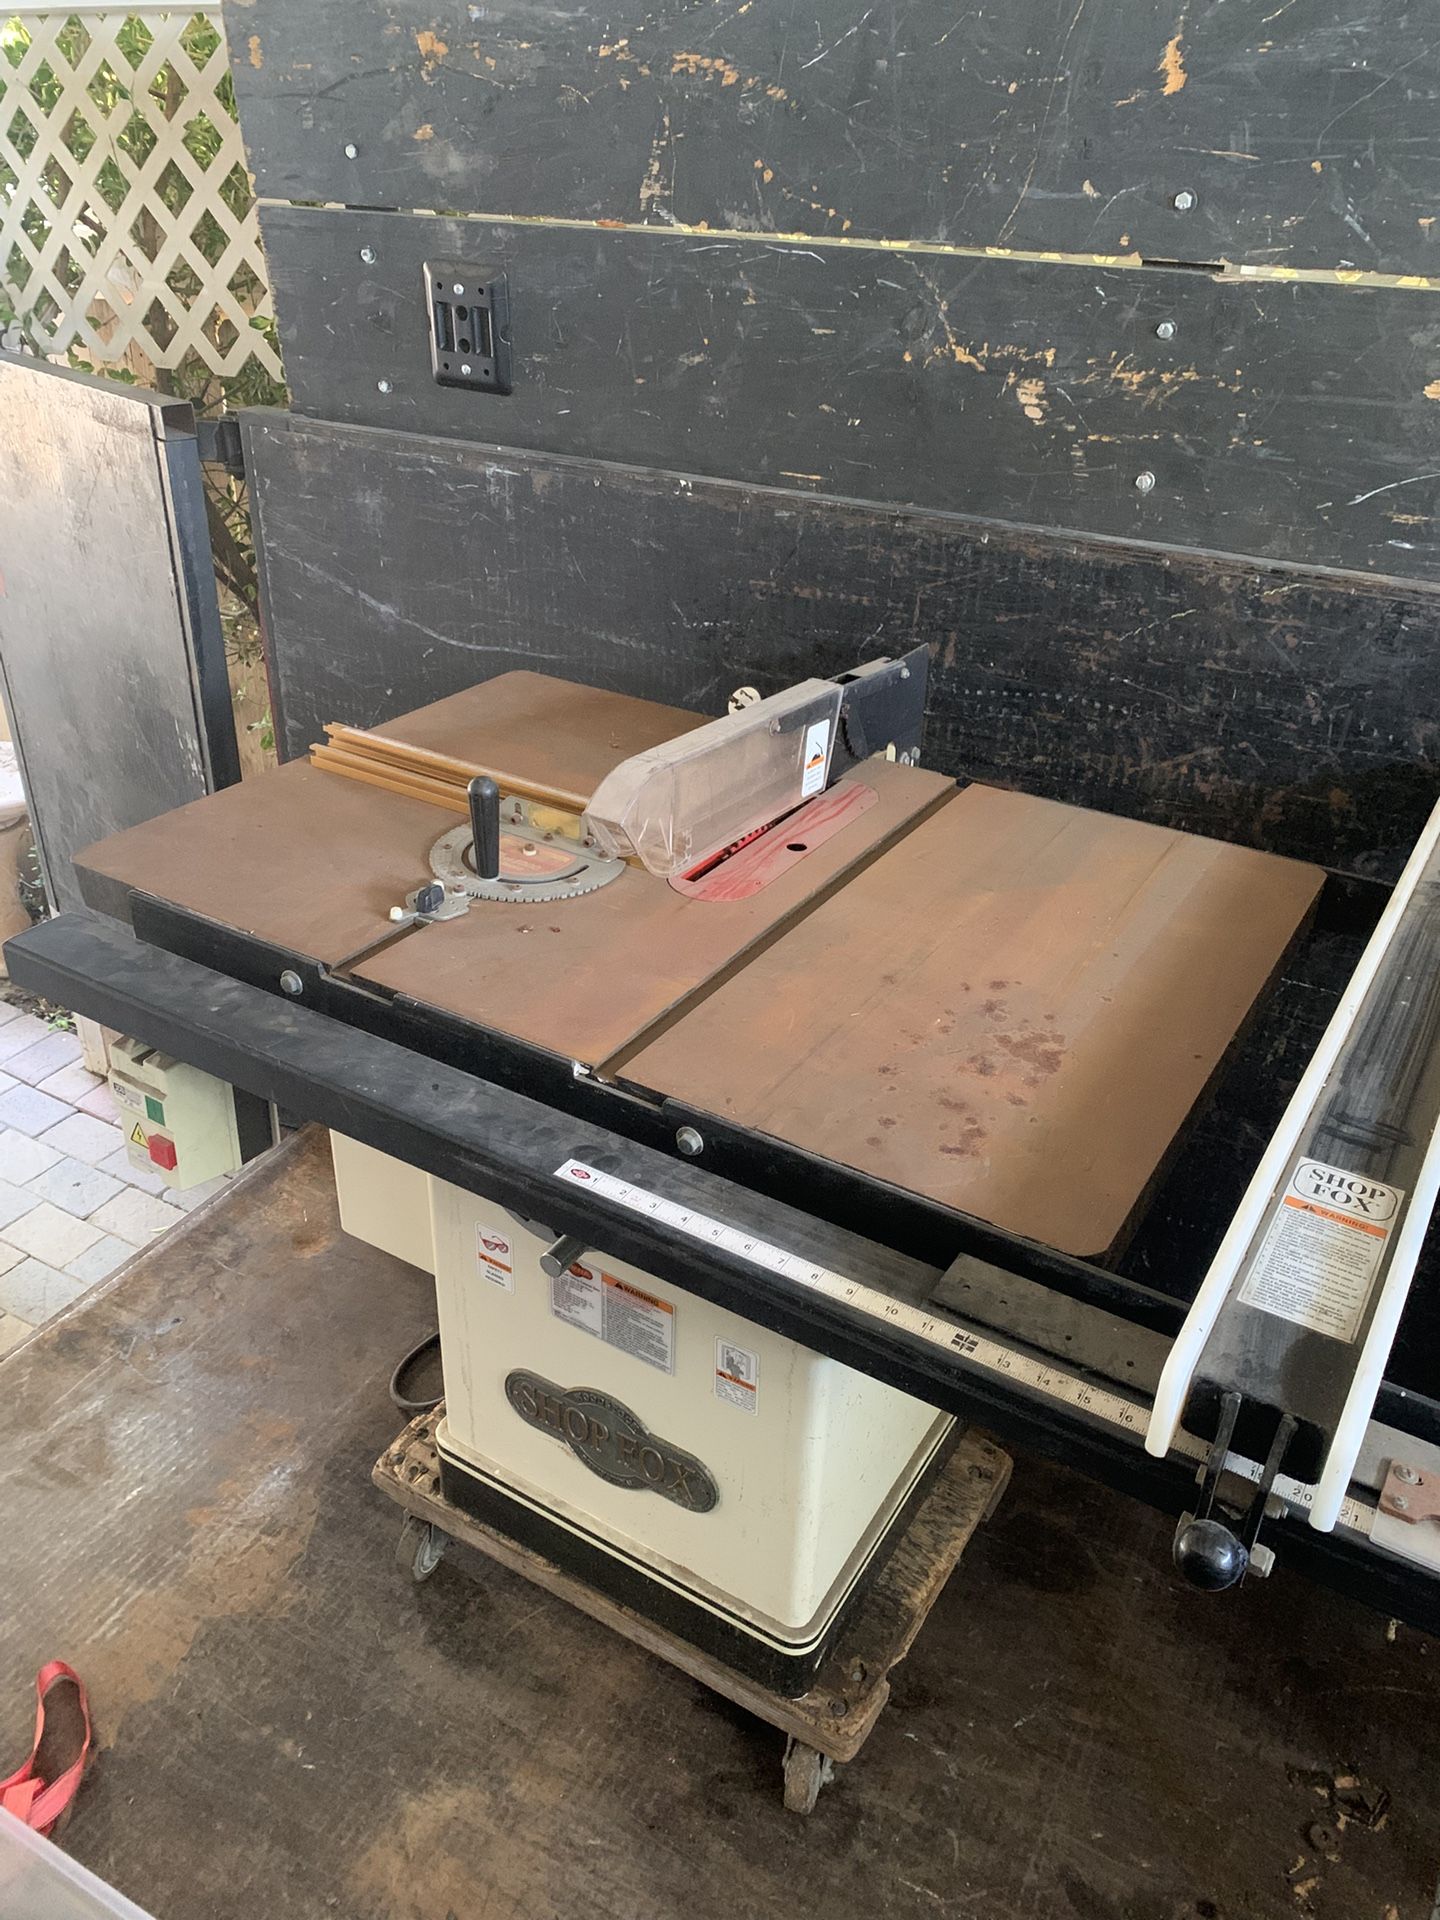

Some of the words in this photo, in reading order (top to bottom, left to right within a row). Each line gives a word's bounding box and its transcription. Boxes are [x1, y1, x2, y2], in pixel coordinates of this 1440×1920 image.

[1309, 1168, 1386, 1200] SHOP
[1312, 1183, 1375, 1213] FOX
[1319, 1209, 1370, 1231] WARNING!
[624, 1285, 660, 1307] WARNING
[885, 1305, 899, 1316] 10
[921, 1322, 935, 1332] 11
[996, 1358, 1011, 1369] 13
[1036, 1375, 1051, 1386] 14
[1076, 1392, 1091, 1405] 15
[1118, 1410, 1134, 1423] 16
[1292, 1487, 1313, 1502] 20
[1340, 1508, 1360, 1523] 21
[512, 1380, 609, 1453] SHOP
[618, 1432, 696, 1503] FOX
